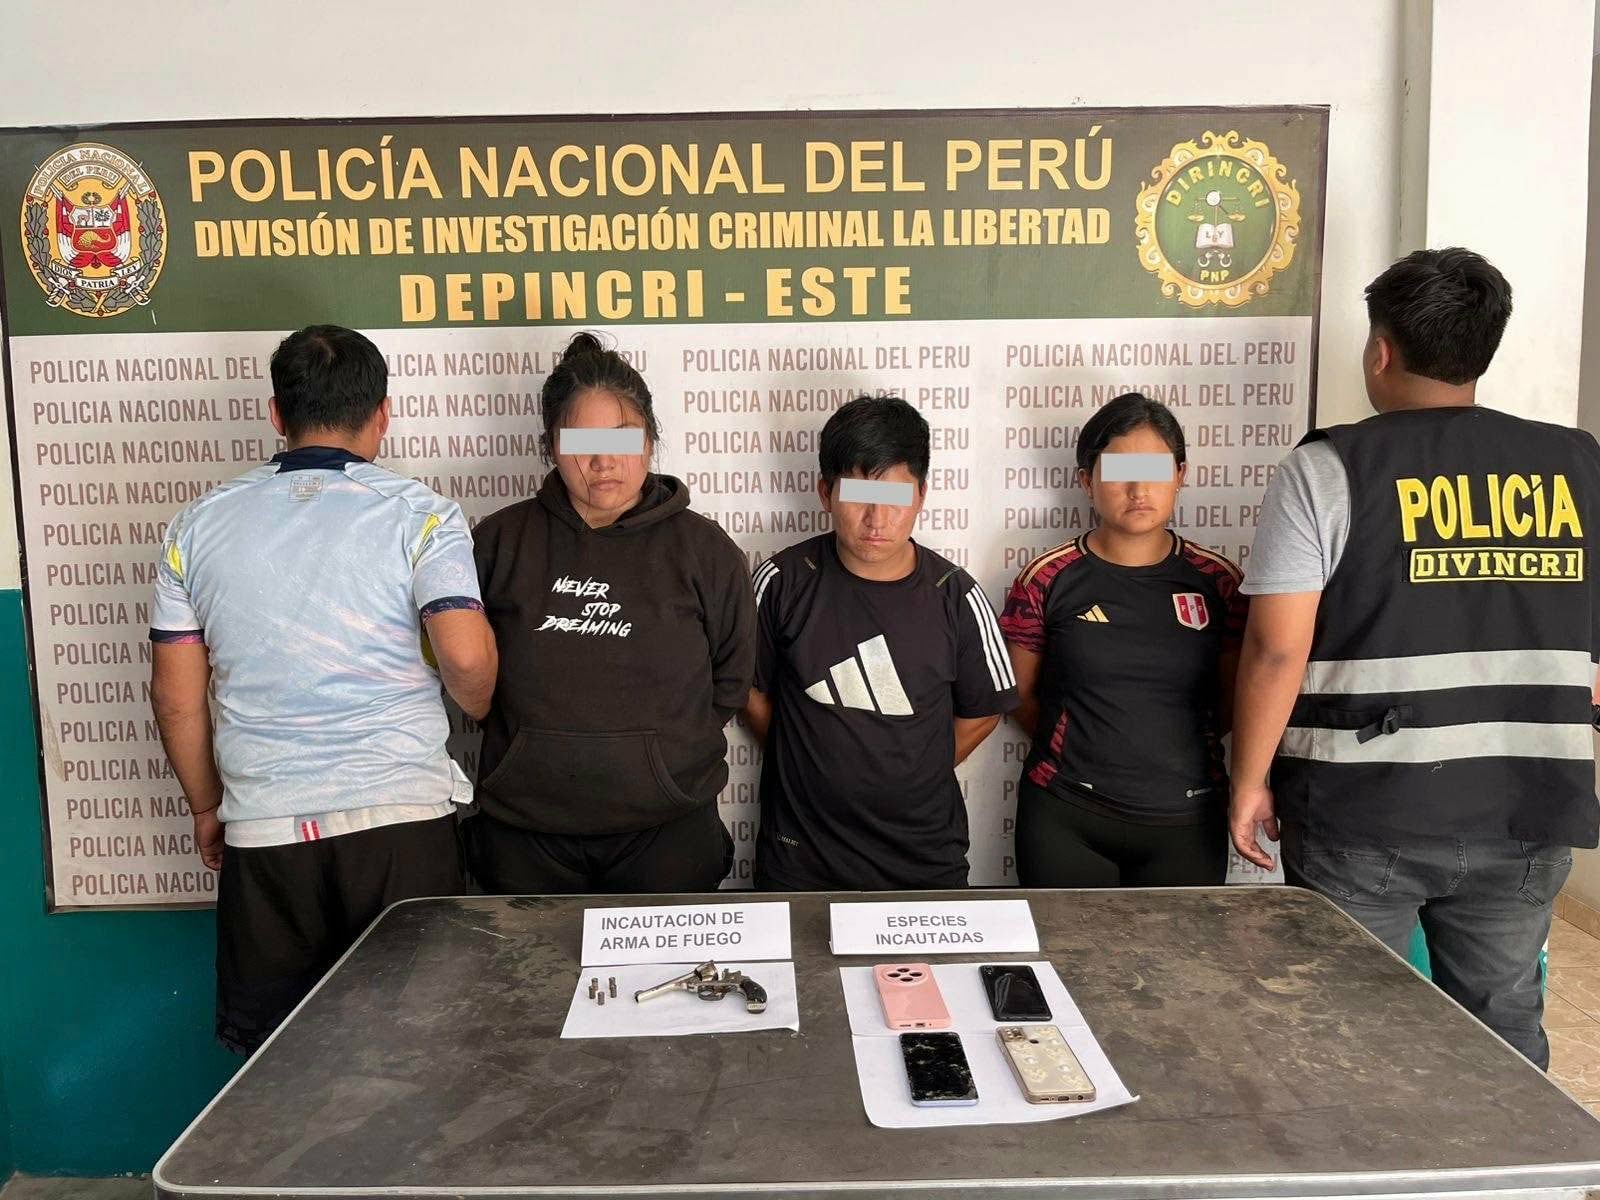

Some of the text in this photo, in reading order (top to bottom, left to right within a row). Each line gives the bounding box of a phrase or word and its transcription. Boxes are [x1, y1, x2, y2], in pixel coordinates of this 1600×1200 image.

[34, 149, 149, 196] POLICIA NACIONAL
[188, 125, 1113, 202] POLICÍA NACIONAL DEL PERÚ
[1165, 160, 1270, 208] DIRINCRI
[194, 206, 1111, 257] DIVISIÓN DE INVESTIGACIÓN CRIMINAL LA LIBERTAD
[54, 265, 74, 277] DIOS
[121, 262, 138, 276] LEY
[1200, 269, 1230, 282] PNP
[80, 279, 116, 289] PATRIA
[399, 266, 912, 322] DEPINCRI - ESTE
[387, 353, 437, 377] LICIA
[444, 351, 545, 375] NACIONAL
[683, 345, 970, 372] POLICIA NACIONAL DEL PERU
[1006, 341, 1296, 368] POLICIA NACIONAL DEL PERU
[31, 356, 264, 384] POLICIA NACIONAL DEL
[389, 395, 439, 418] LICIA
[684, 390, 762, 413] POLICIA
[918, 387, 969, 410] PERU
[1005, 386, 1083, 409] POLICIA
[1200, 384, 1235, 407] DEL
[1242, 383, 1294, 406] PERU
[33, 397, 266, 425] POLICIA NACIONAL DEL
[379, 434, 441, 459] OLICIA
[685, 430, 762, 454] POLICIA
[931, 428, 969, 451] ERU
[1198, 424, 1234, 448] DEL
[1241, 423, 1292, 447] PERU
[37, 441, 116, 466] POLICIA
[122, 440, 225, 464] NACIONAL
[231, 438, 269, 462] DEL
[450, 475, 544, 498] NACIONA
[686, 471, 763, 494] POLICIA
[930, 468, 969, 491] ERU
[1005, 467, 1081, 490] POLICIA
[1197, 465, 1233, 488] DEL
[1240, 464, 1279, 487] PER
[40, 482, 120, 506] POLICIA
[771, 510, 831, 533] NACIO
[918, 507, 969, 531] PERU
[1004, 507, 1081, 530] POLICIA
[1196, 505, 1232, 528] DEL
[43, 523, 122, 546] POLICIA
[47, 562, 126, 586] POLICIA
[1415, 552, 1577, 577] DIVINCRI
[551, 575, 610, 600] NEVER
[51, 603, 129, 626] POLICIA
[581, 602, 622, 618] STOP
[534, 615, 632, 638] DREAMING
[54, 643, 132, 665] POLICIA
[57, 682, 135, 704] POLICIA
[60, 721, 138, 743] POLICIA
[64, 759, 141, 781] POLICIA
[67, 798, 144, 819] POLICIA
[70, 836, 146, 858] POLICIA
[72, 871, 215, 896] POLICIA NACIO
[601, 911, 744, 930] INCAUTACION DE
[886, 914, 967, 928] ESPECIES
[600, 931, 742, 950] ARMA DE FUEGO
[875, 931, 984, 945] INCAUTADAS
